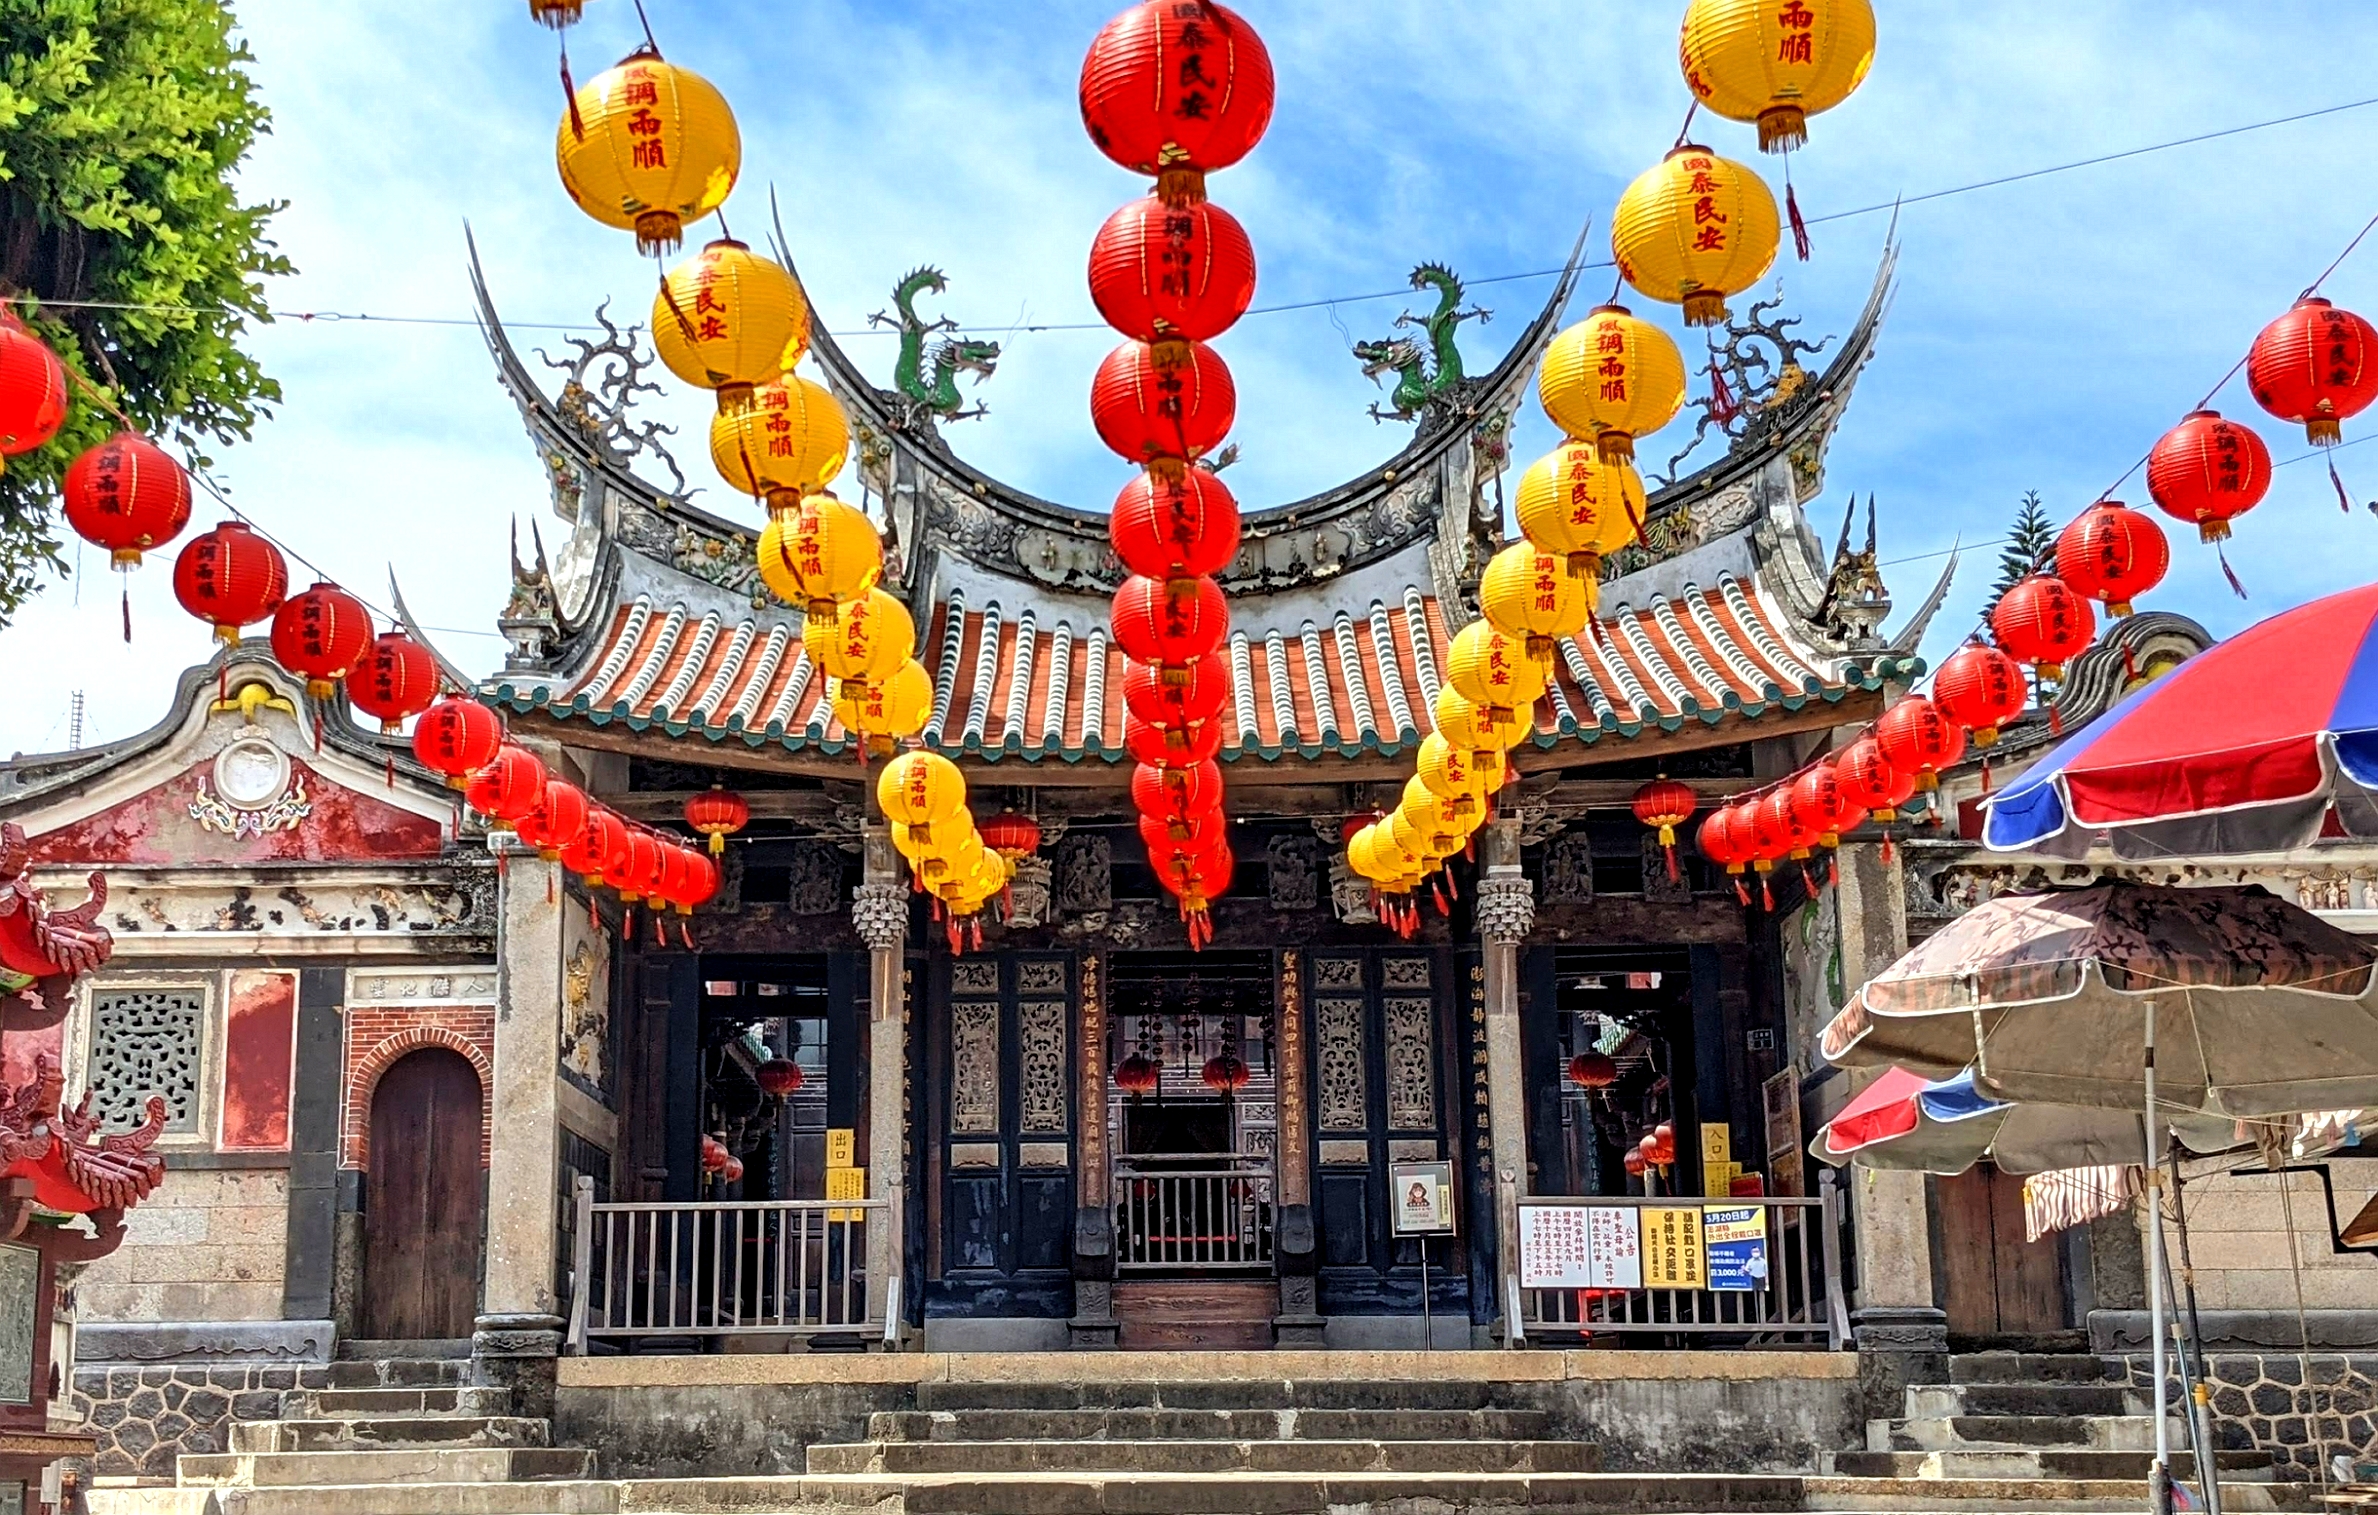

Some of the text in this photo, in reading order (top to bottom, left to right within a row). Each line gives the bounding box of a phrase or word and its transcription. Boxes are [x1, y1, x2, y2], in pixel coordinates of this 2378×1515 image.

[1173, 3, 1217, 121] 國泰民安
[1683, 158, 1727, 252] 國泰民安
[1596, 319, 1627, 402] 風調雨順
[2320, 311, 2355, 387] 國泰民安
[1567, 450, 1597, 525] 國泰民安
[844, 592, 870, 659] 泰民安
[836, 1133, 846, 1160] 出口
[1711, 1129, 1723, 1154] 入口
[1532, 1210, 1543, 1277] 上午七時至下午五時
[1552, 1210, 1563, 1277] 上午七時至下午七時
[1625, 1225, 1636, 1257] 公告
[1664, 1211, 1678, 1281] 保持社交距離
[1706, 1209, 1750, 1223] 5月20日起
[1708, 1229, 1762, 1241] 外出全程戴口罩
